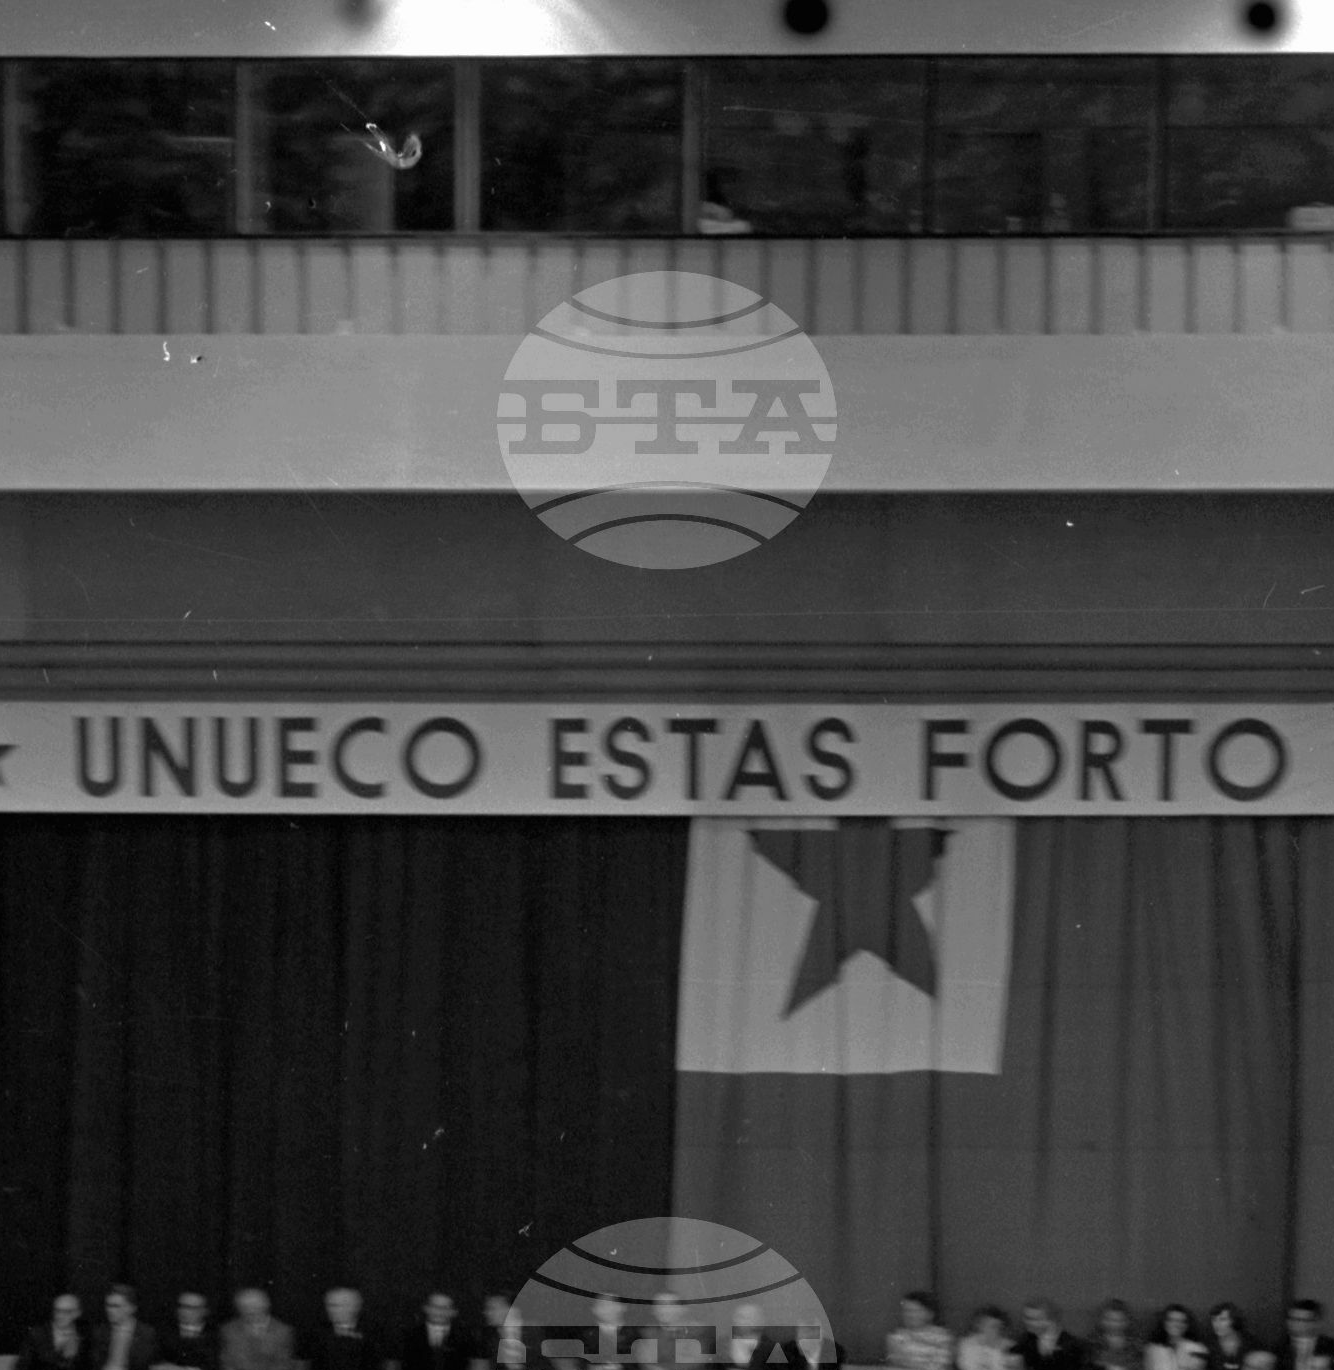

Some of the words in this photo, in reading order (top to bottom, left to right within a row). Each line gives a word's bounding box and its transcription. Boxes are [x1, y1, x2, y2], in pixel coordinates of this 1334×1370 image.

[74, 716, 484, 799] UNUECO
[550, 716, 858, 800] ESTAS
[922, 717, 1289, 801] FORTO
